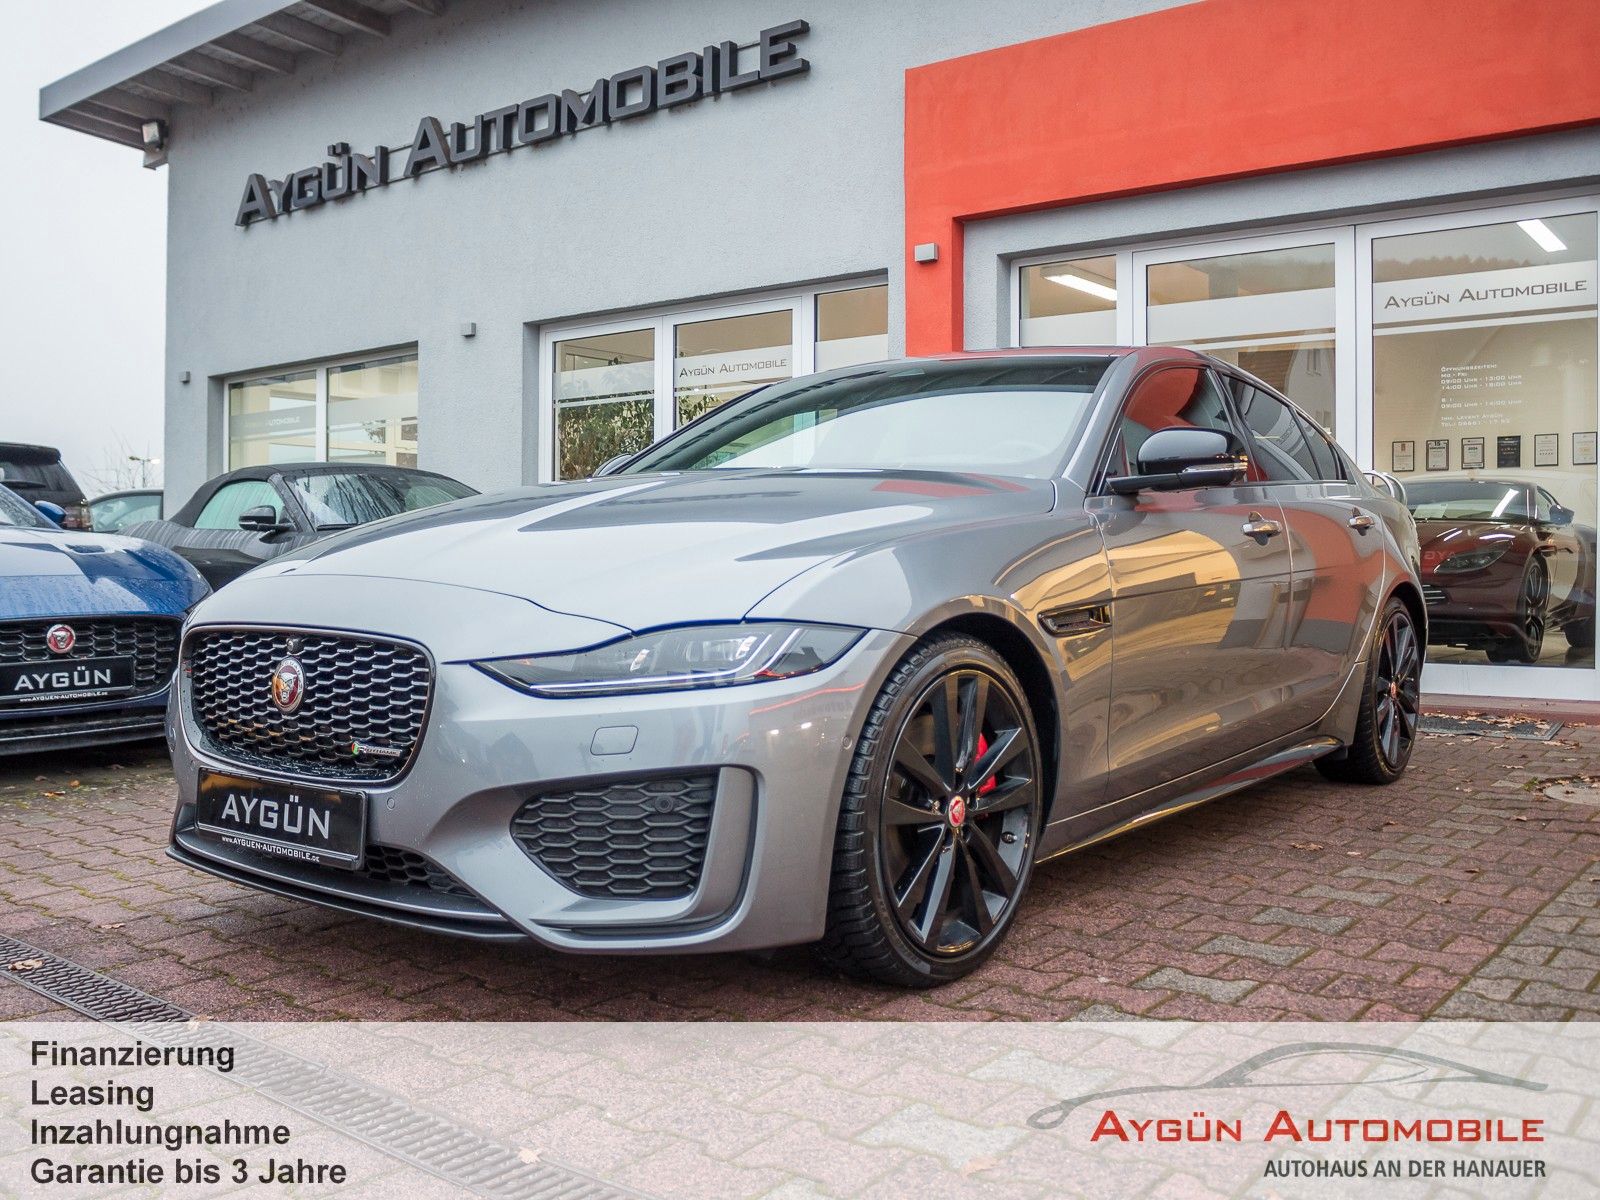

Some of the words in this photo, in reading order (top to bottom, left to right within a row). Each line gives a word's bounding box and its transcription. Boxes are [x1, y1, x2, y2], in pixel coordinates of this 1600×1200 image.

[235, 142, 390, 227] AYGÜN
[404, 19, 811, 178] AUTOMOBILE
[1384, 291, 1450, 310] AYGÜN
[1459, 279, 1587, 303] AUTOMOBILE
[720, 358, 788, 374] AUTOMOBILE
[14, 665, 111, 691] AYGÜN
[221, 793, 330, 840] AYGÜN
